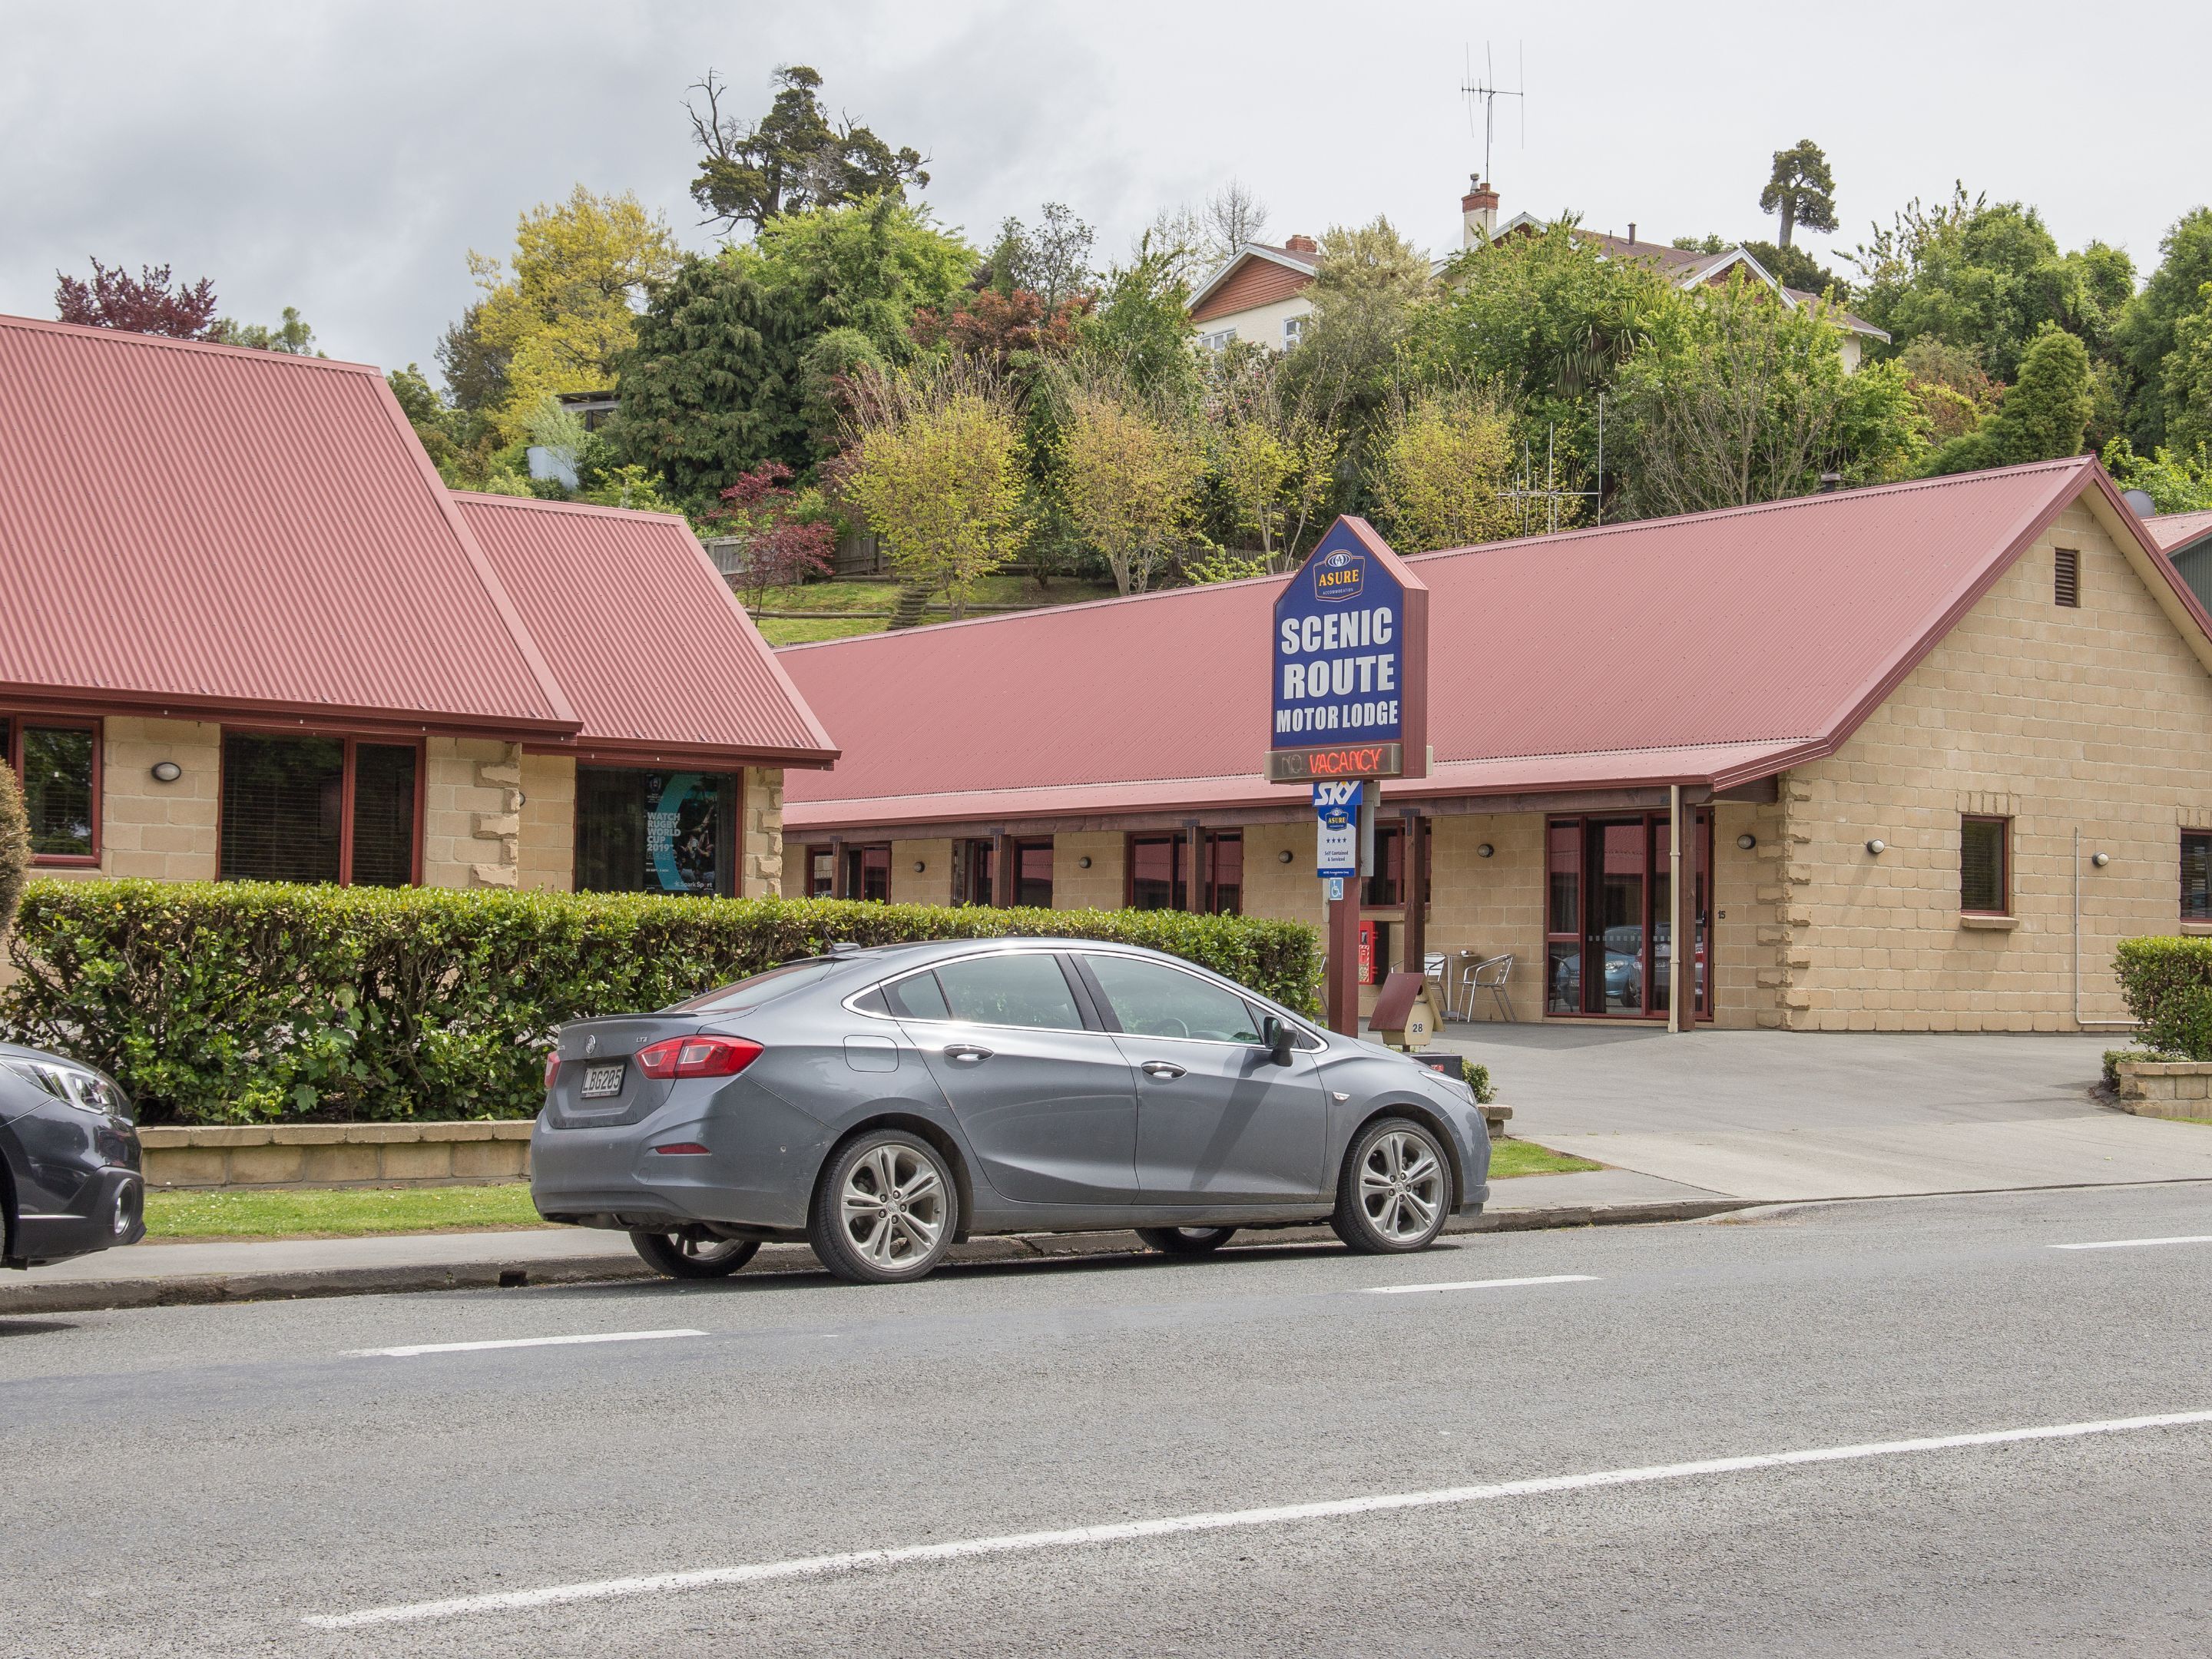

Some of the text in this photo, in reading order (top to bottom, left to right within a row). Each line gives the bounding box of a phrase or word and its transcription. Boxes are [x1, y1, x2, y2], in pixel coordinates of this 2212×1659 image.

[1319, 569, 1359, 587] ASURE
[1281, 607, 1392, 654] SCENIC
[1283, 654, 1395, 700] ROUTE
[1277, 700, 1398, 733] MOTOR LODGE
[1281, 748, 1382, 775] NO VACANCY
[1314, 780, 1361, 806] SKY
[647, 812, 680, 821] WATCH
[647, 820, 678, 829] RUGBY
[647, 828, 681, 836] WORLD
[647, 836, 666, 844] CUP
[1717, 909, 1727, 919] 15
[1412, 1023, 1423, 1032] 28
[582, 1068, 622, 1091] LBG205
